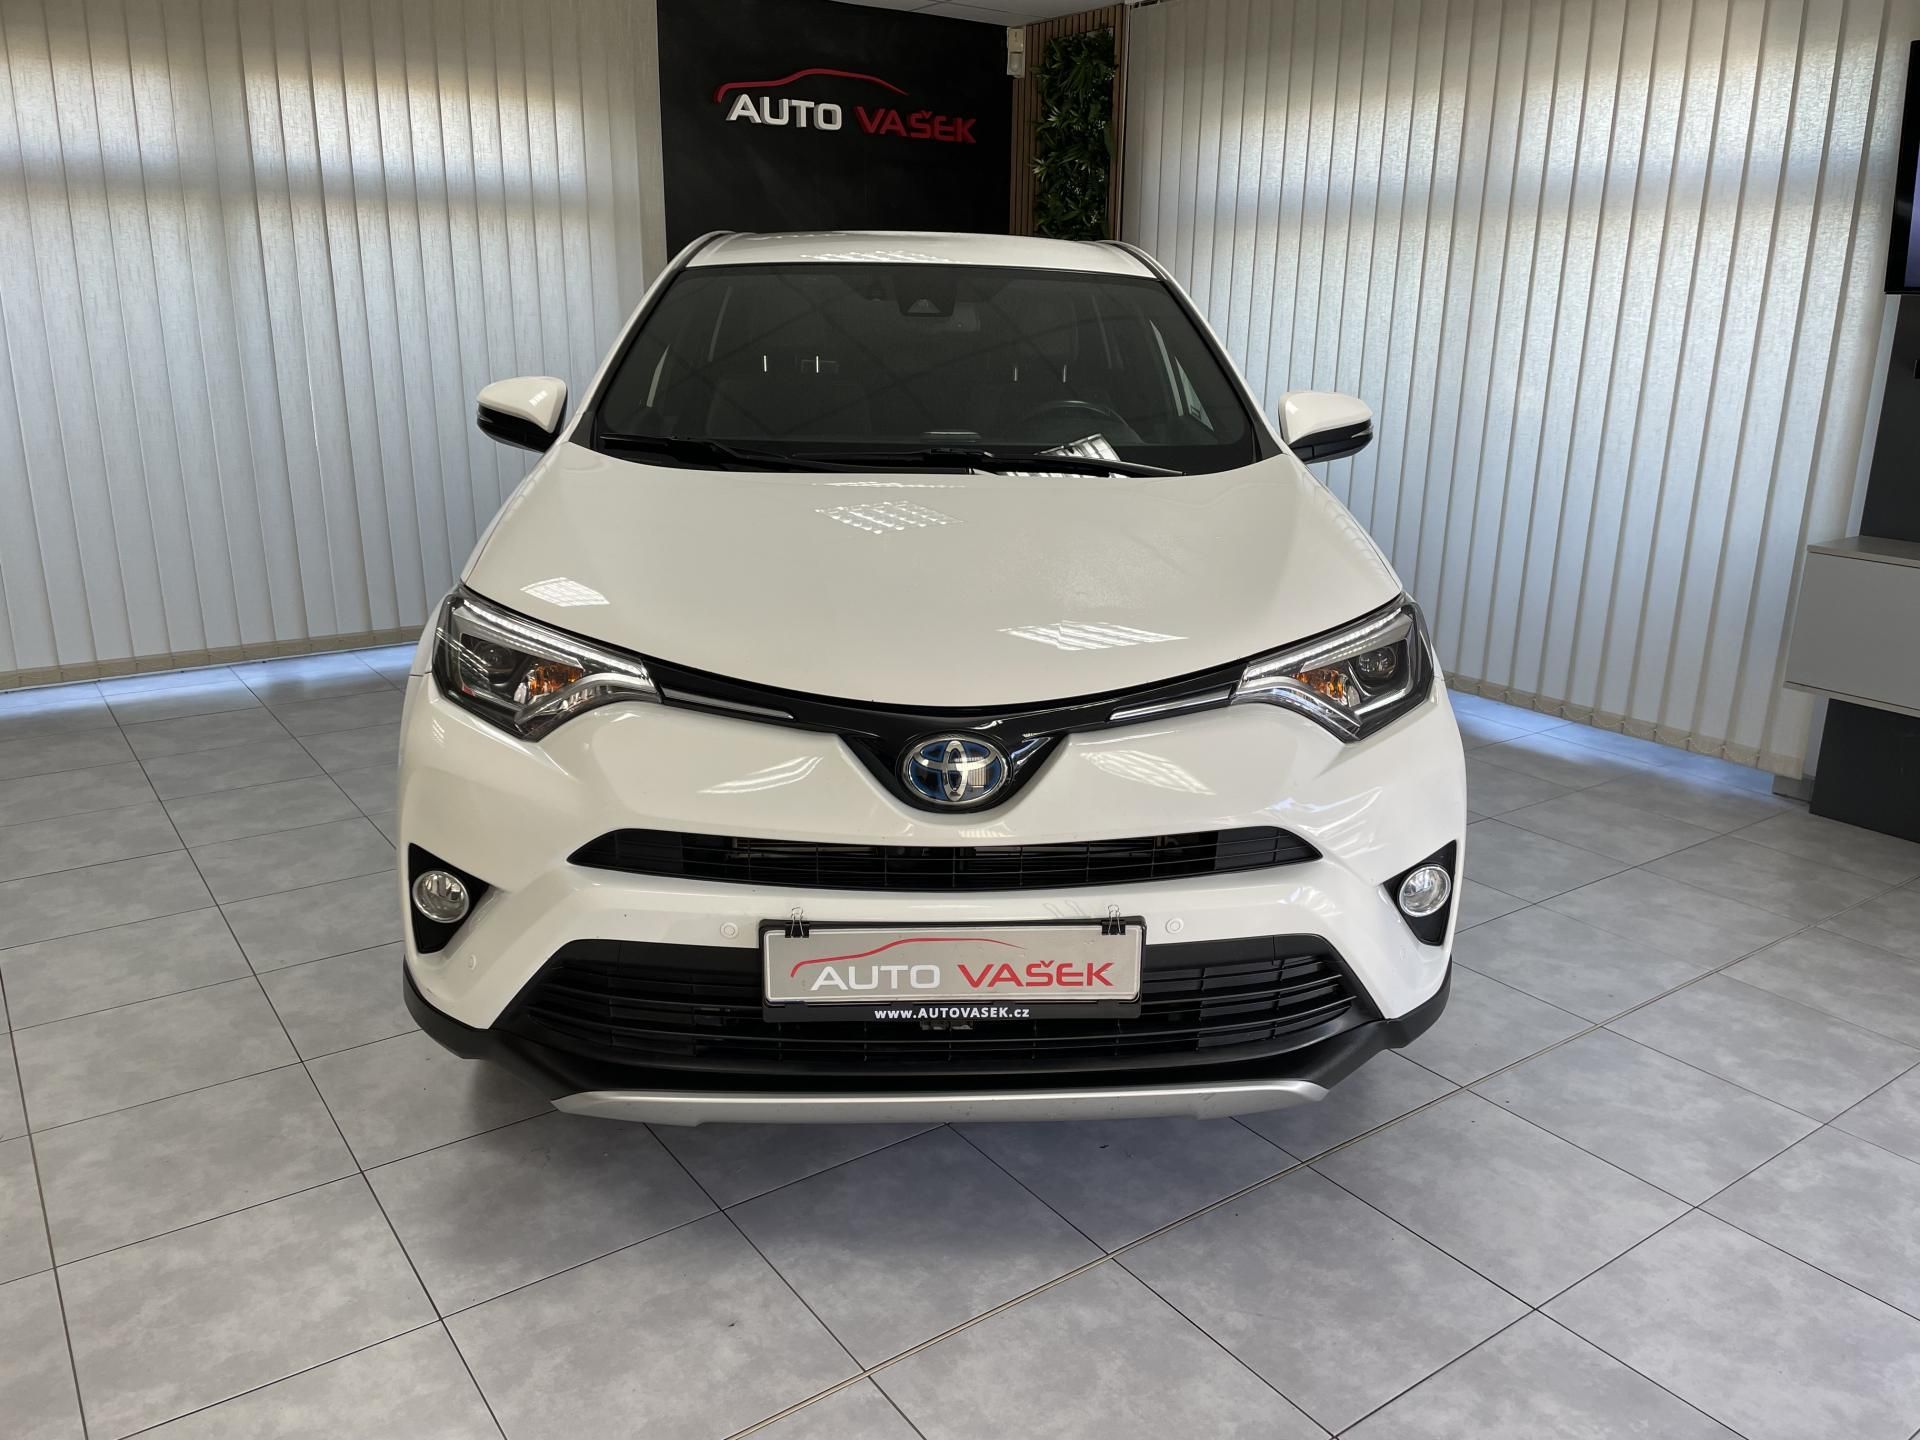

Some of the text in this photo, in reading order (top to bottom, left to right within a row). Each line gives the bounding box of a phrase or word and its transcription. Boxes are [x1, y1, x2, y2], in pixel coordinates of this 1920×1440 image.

[725, 93, 977, 144] AUTO VAŠEK
[810, 960, 1115, 991] AUTO VAŠEK
[874, 1006, 1030, 1019] www.AUTOVASEK.cz
